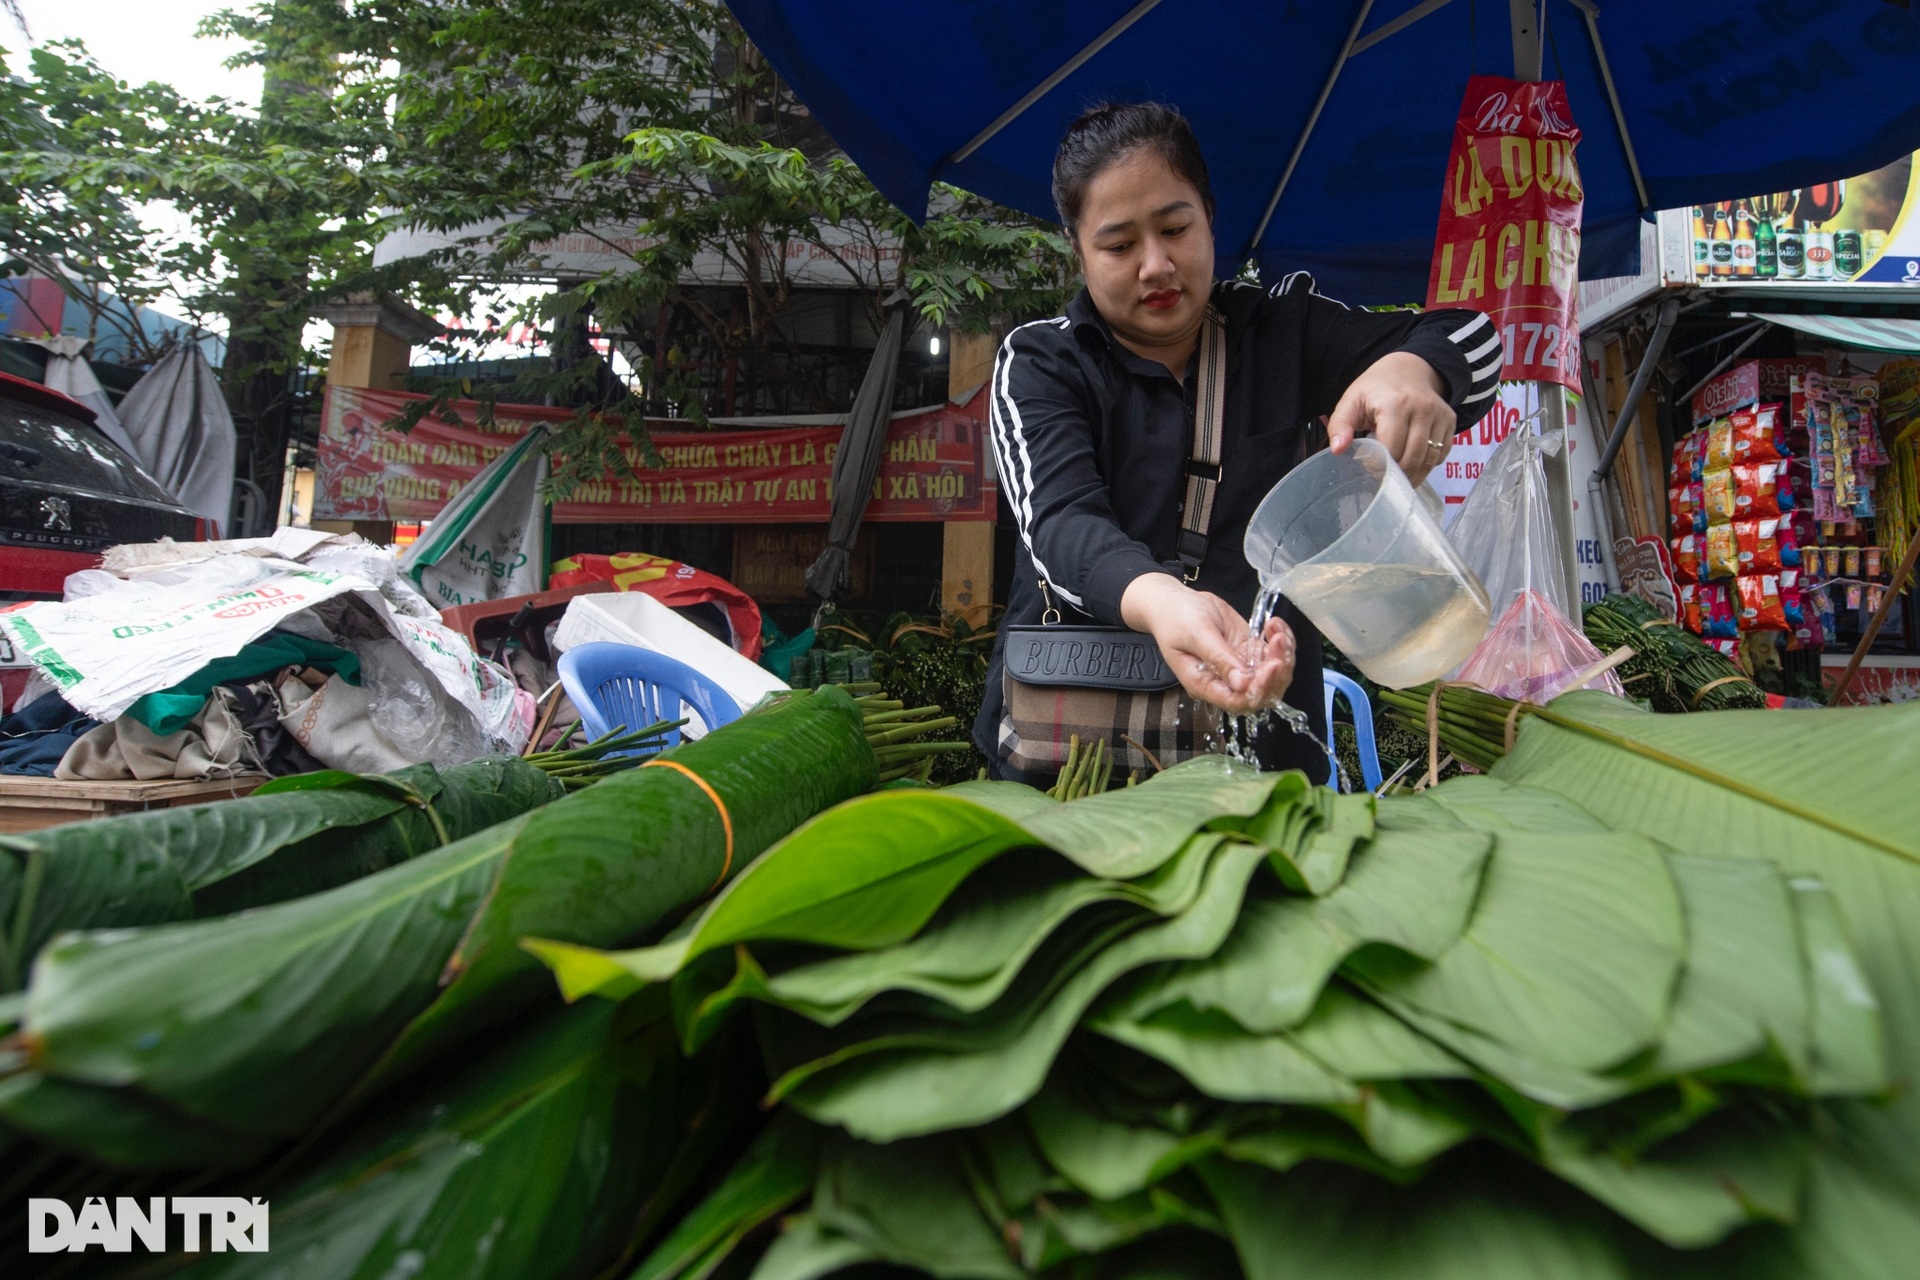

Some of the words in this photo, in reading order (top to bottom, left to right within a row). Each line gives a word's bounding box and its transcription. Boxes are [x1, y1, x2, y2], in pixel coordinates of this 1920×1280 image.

[1475, 91, 1523, 134] Bà
[1436, 223, 1487, 304] LÁ
[1811, 250, 1827, 259] 333
[1835, 252, 1861, 260] SPECIAL
[1704, 375, 1740, 410] Oishi
[371, 438, 426, 465] TOÀN
[431, 440, 477, 467] DÂN
[725, 440, 783, 468] CHÁY
[790, 438, 817, 466] LÀ
[1446, 462, 1462, 479] ĐT:
[618, 481, 650, 508] TRỊ
[658, 477, 687, 504] VÀ
[693, 476, 747, 507] TRẬT
[753, 478, 783, 506] TỰ
[784, 478, 817, 502] AN
[889, 472, 920, 500] XÃ
[926, 470, 964, 504] HỘI
[12, 531, 95, 547] PEUGEOT
